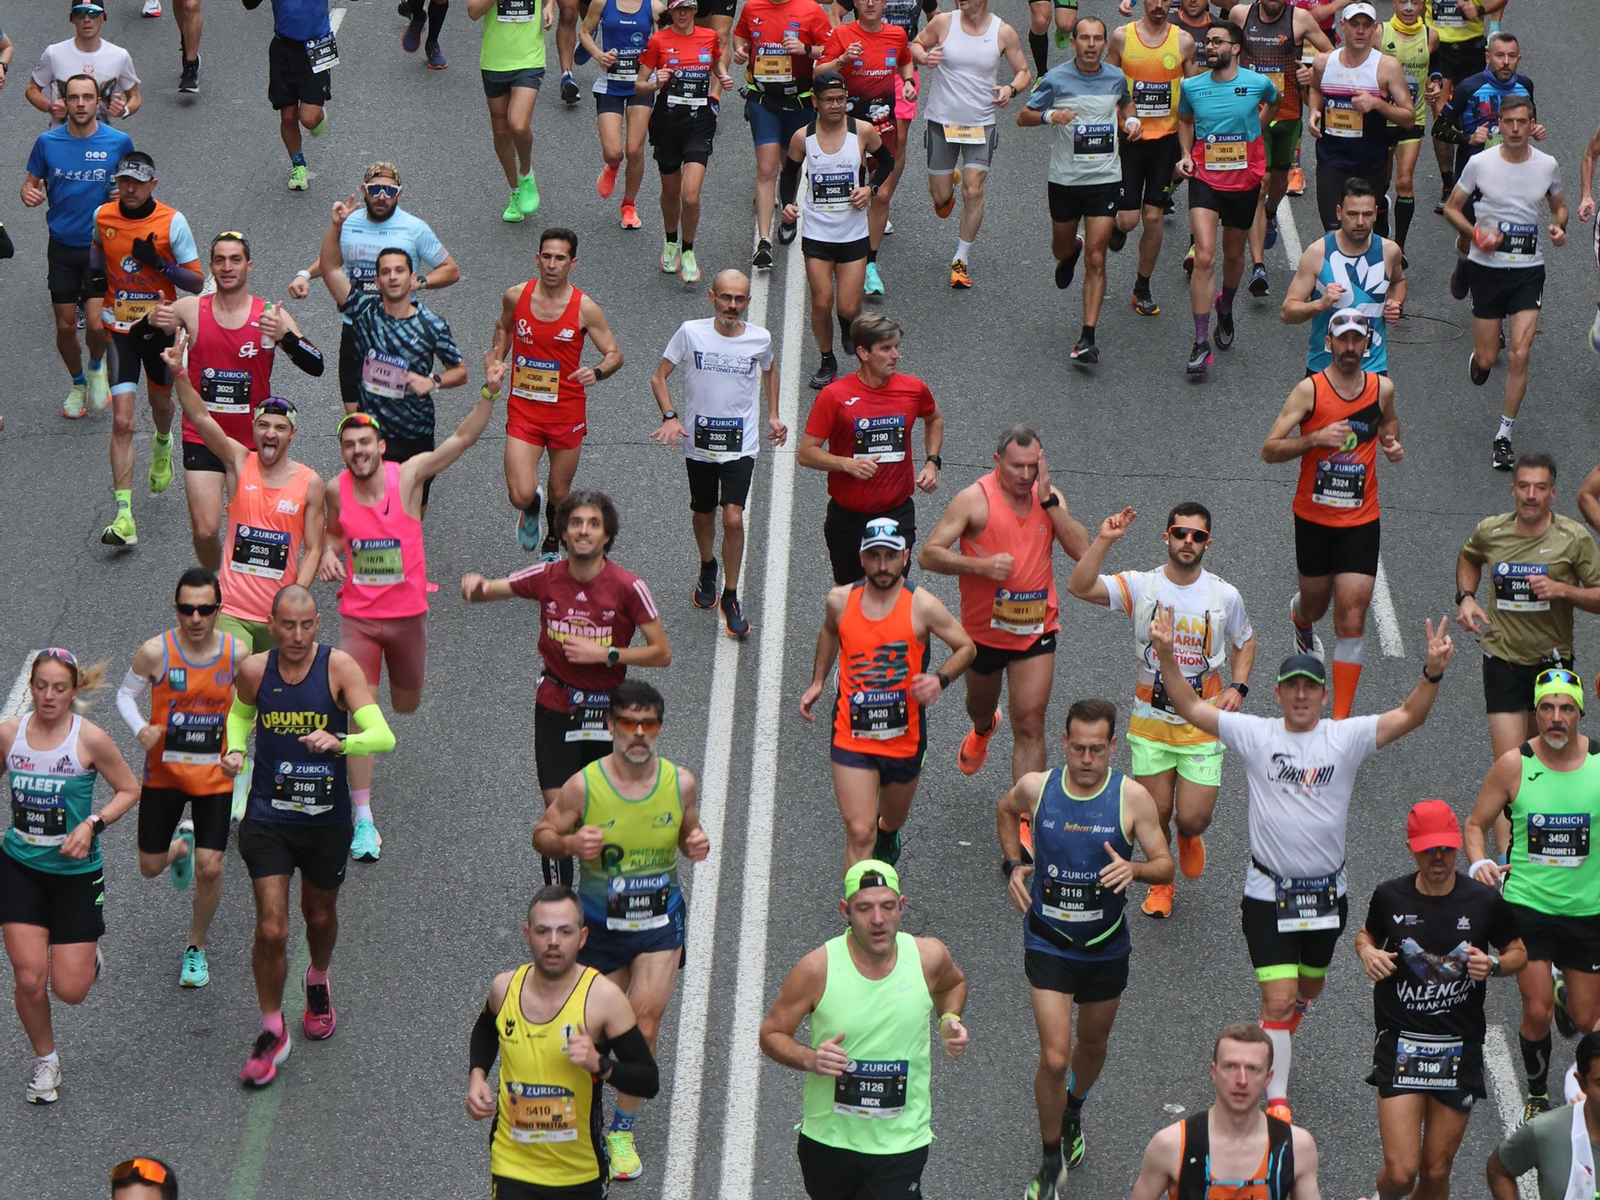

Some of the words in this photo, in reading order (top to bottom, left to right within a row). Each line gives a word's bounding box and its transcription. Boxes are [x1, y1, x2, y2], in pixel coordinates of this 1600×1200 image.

[685, 70, 706, 78] ZURICH
[1146, 82, 1169, 90] ZURICH
[1088, 125, 1110, 133] ZURICH
[825, 173, 849, 182] ZURICH
[826, 187, 841, 195] 2562
[1513, 224, 1535, 232] ZURICH
[378, 354, 404, 367] ZURICH
[528, 360, 554, 369] ZURICH
[216, 385, 234, 393] 3025
[711, 419, 738, 427] ZURICH
[872, 417, 899, 426] ZURICH
[709, 433, 726, 441] 3352
[872, 433, 888, 442] 2190
[253, 529, 284, 540] ZURICH
[364, 540, 395, 549] ZURICH
[250, 545, 269, 555] 2535
[1512, 566, 1542, 574] ZURICH
[588, 694, 610, 702] ZURIC
[868, 691, 899, 702] ZURICH
[584, 710, 603, 718] 2111
[869, 709, 888, 719] 3420
[188, 715, 219, 724] ZURICH
[261, 711, 328, 729] UBUNTU
[582, 721, 604, 729] LUISMI
[871, 722, 888, 730] ALEX
[296, 766, 328, 774] ZURICH
[12, 776, 65, 793] ATLEET
[294, 783, 315, 792] 3160
[27, 796, 58, 805] ZURICH
[291, 795, 316, 804] HELIOS
[1549, 816, 1583, 825] ZURICH
[1549, 834, 1569, 843] 3450
[1542, 847, 1576, 855] ANDIHE13
[1062, 870, 1097, 879] ZURICH
[630, 877, 663, 889] ZURICH
[1061, 888, 1082, 898] 3118
[1059, 901, 1084, 910] ALBIAC
[1299, 909, 1317, 917] TORO
[1416, 995, 1468, 1011] MARATÓN
[862, 1060, 900, 1072] ZURICH
[1418, 1062, 1440, 1073] 3190
[1398, 1076, 1457, 1086] LUISA&LOURDES
[523, 1086, 565, 1095] ZURICH
[859, 1083, 884, 1093] 3126
[861, 1097, 880, 1106] NICK
[527, 1106, 550, 1115] 5410
